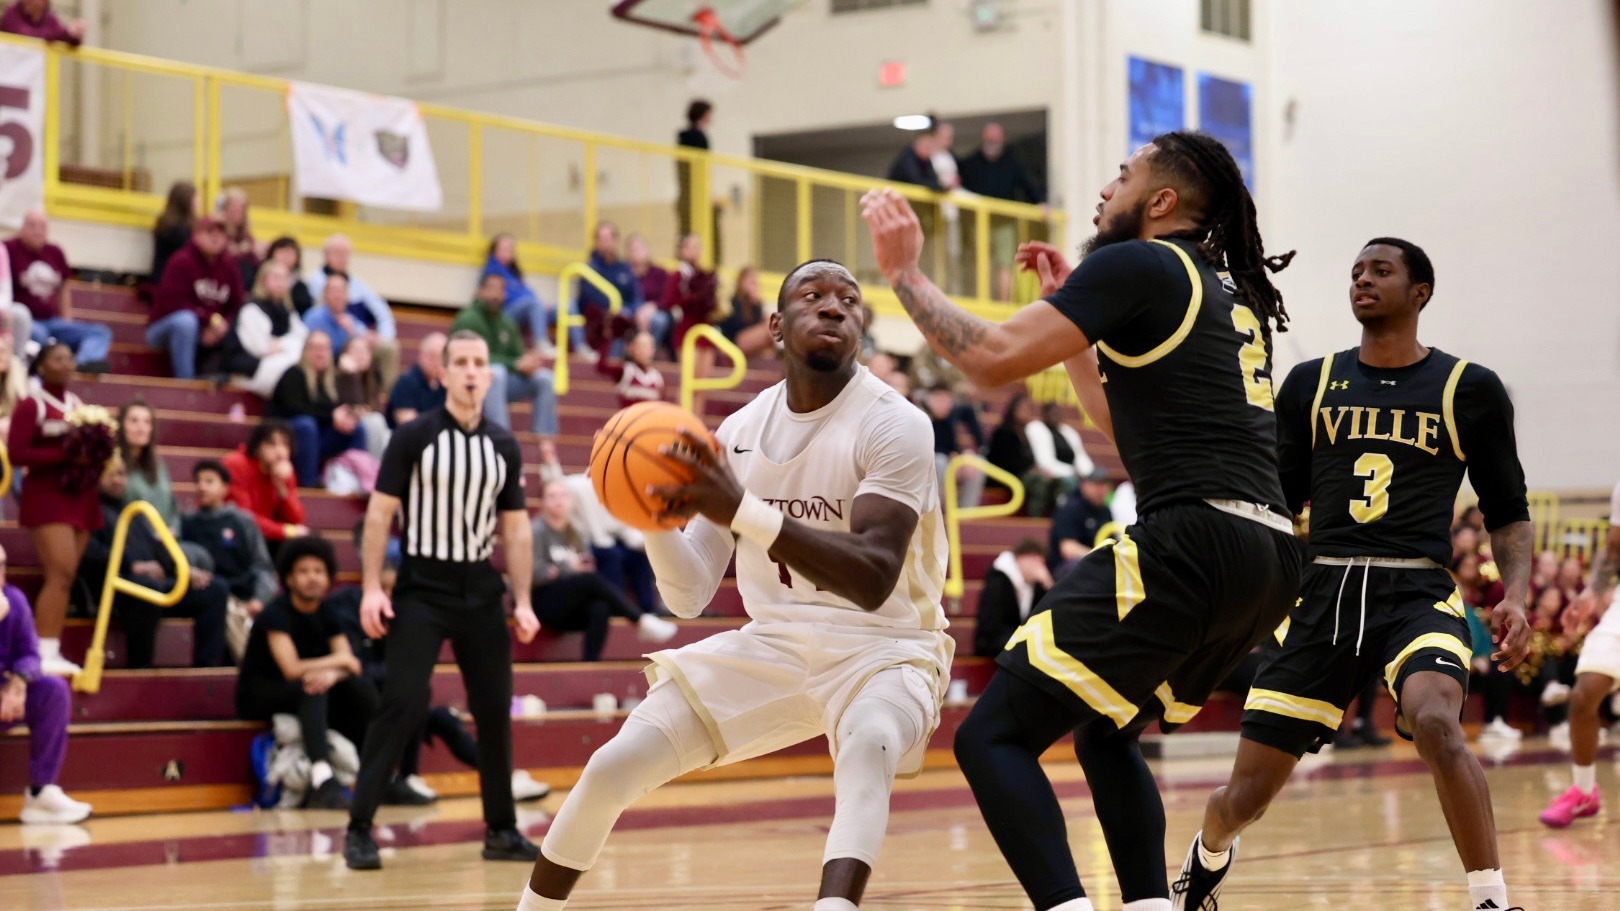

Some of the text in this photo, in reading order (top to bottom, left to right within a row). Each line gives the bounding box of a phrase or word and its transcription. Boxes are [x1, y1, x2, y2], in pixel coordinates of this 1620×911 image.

[1230, 303, 1275, 412] 2
[1320, 406, 1440, 456] VILLE
[1349, 452, 1394, 524] 3
